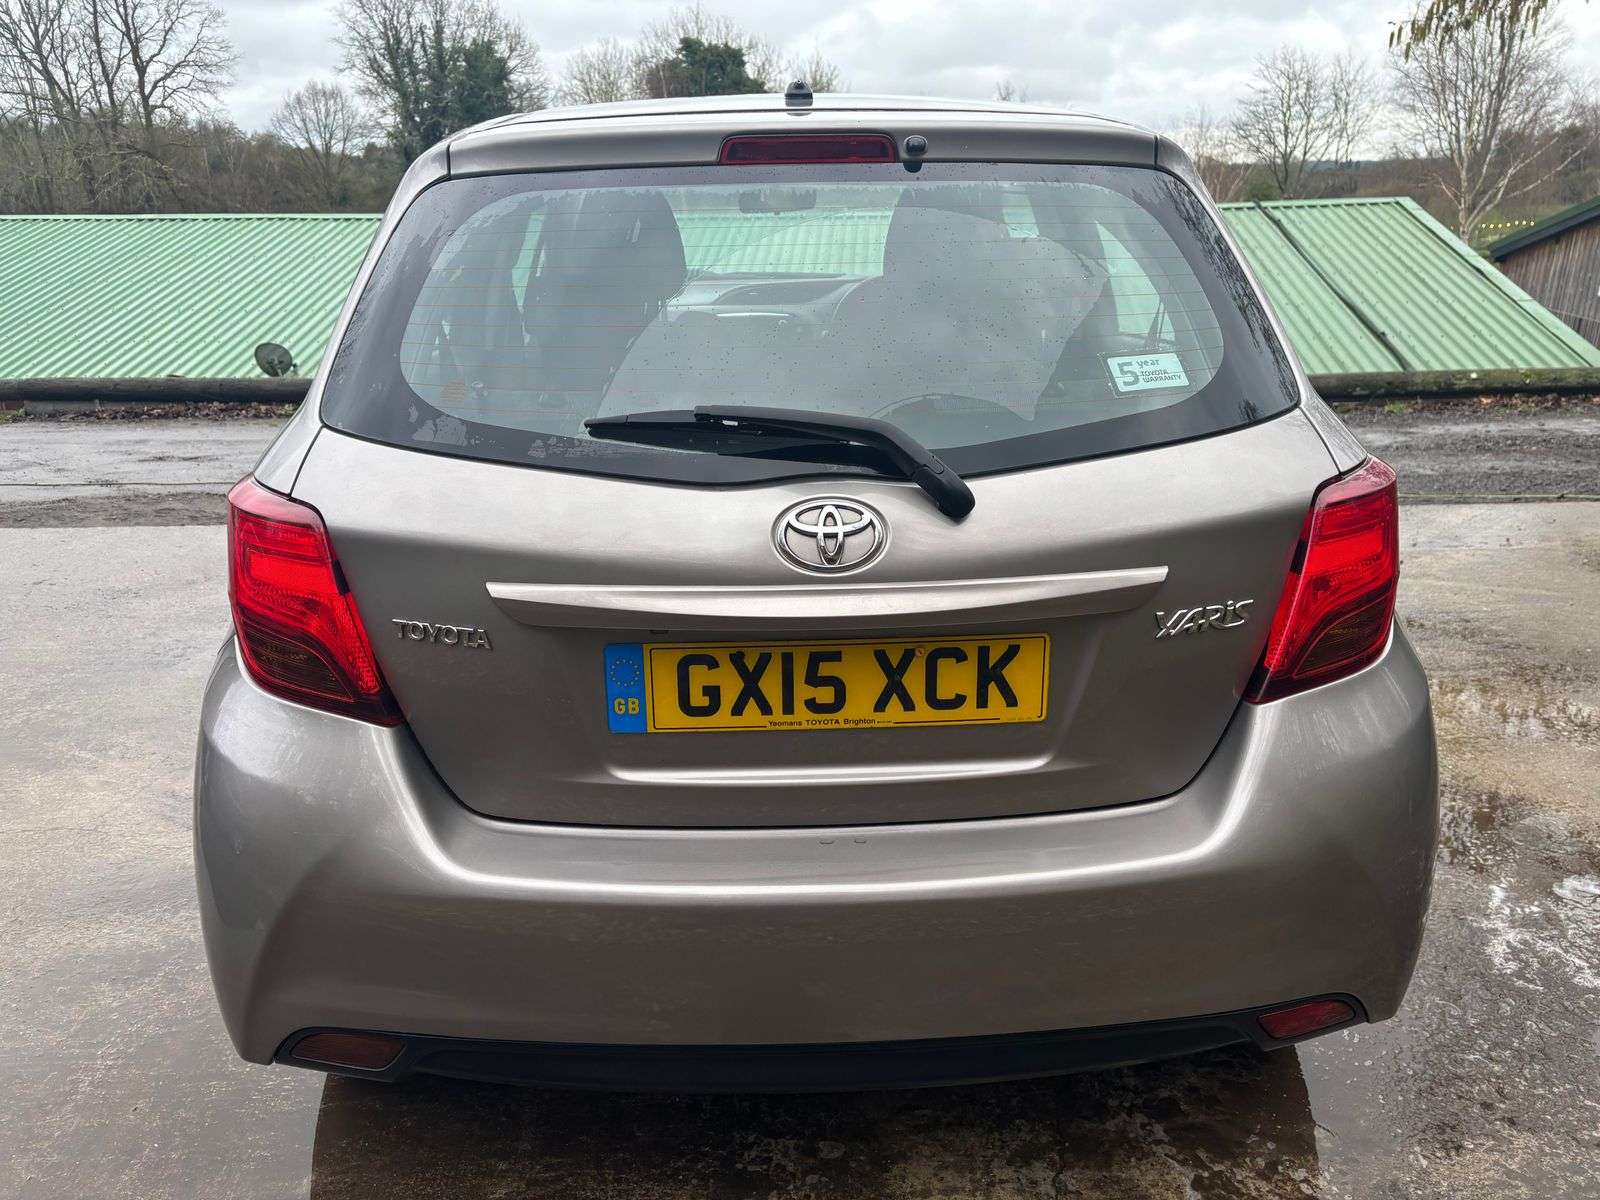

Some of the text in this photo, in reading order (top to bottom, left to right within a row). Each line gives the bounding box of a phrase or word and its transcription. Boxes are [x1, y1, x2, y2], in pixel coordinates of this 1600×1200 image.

[1136, 359, 1160, 369] year
[1117, 361, 1140, 386] 5
[1142, 374, 1181, 383] WARRANTY
[392, 618, 493, 650] TOYOTA
[676, 644, 1021, 718] GX15 XCK
[613, 698, 640, 714] GB
[843, 718, 876, 726] Brighton
